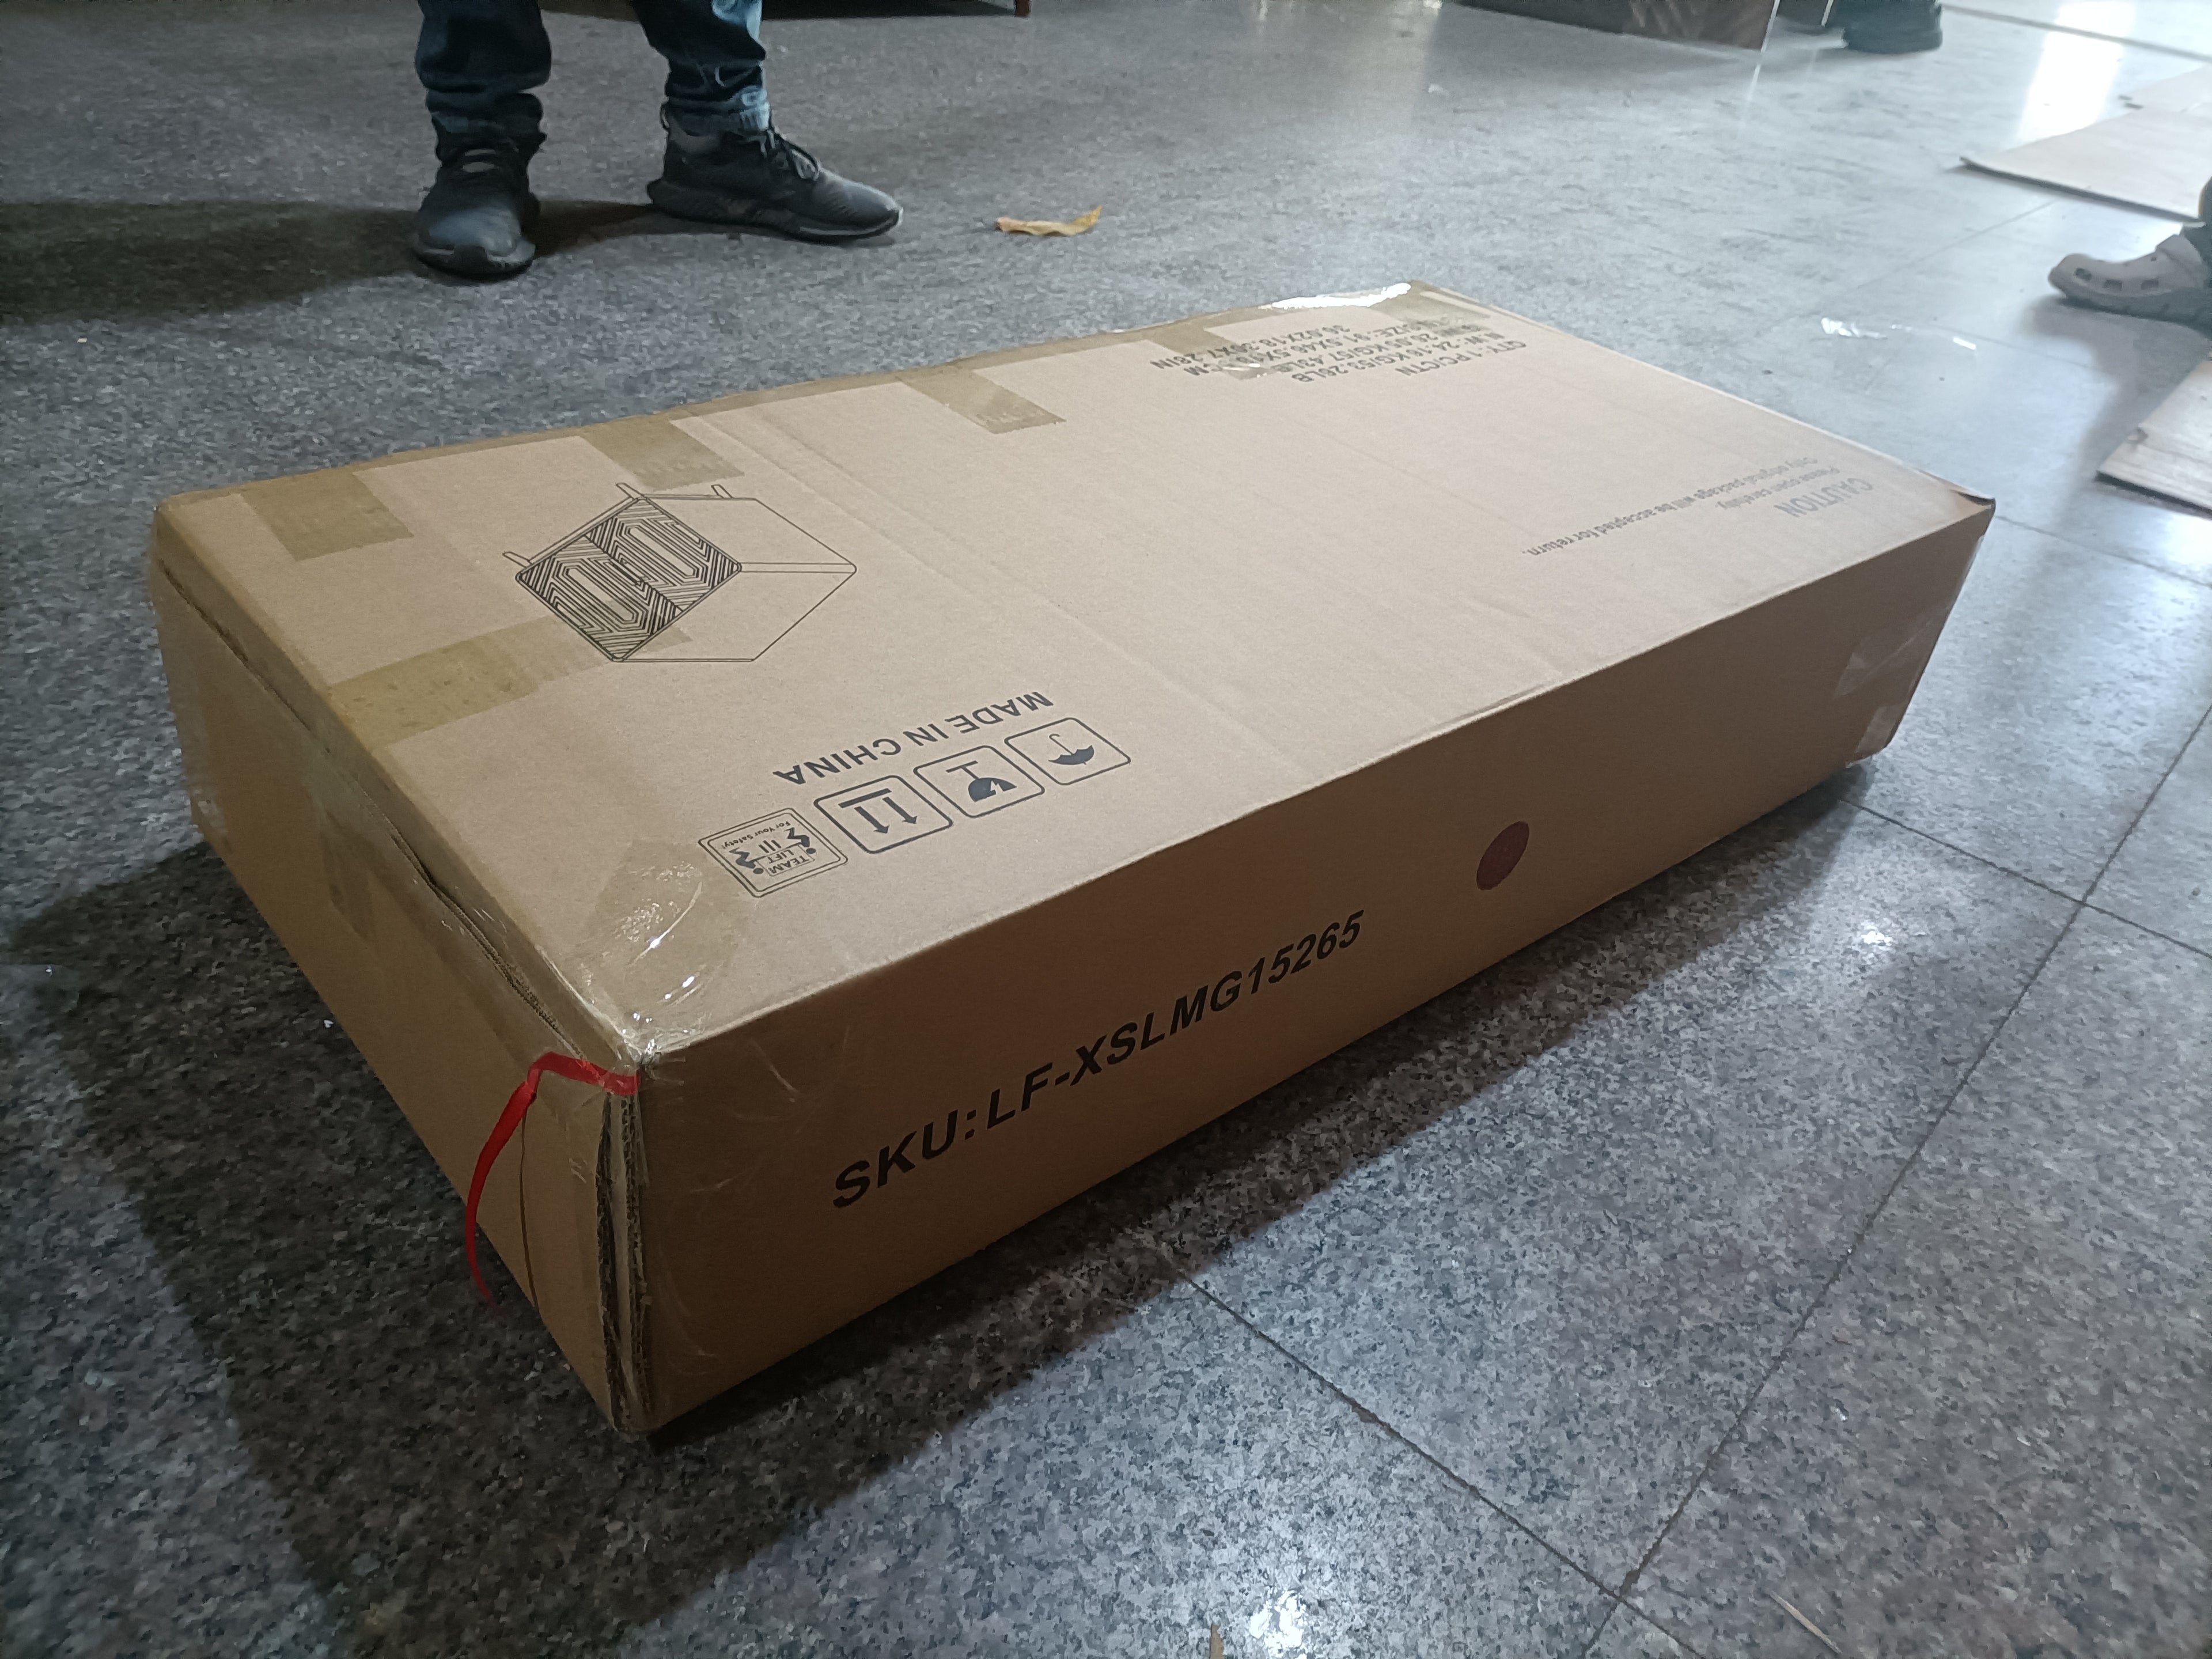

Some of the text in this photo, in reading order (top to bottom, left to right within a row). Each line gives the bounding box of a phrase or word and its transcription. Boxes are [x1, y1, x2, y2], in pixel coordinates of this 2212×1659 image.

[1479, 340, 1526, 354] QTY:
[1395, 353, 1471, 376] PC/CTN
[1694, 479, 1745, 499] package
[1774, 478, 1873, 517] CAUTION
[1654, 503, 1677, 512] be
[1594, 509, 1657, 535] accepted
[1573, 530, 1600, 540] for
[1522, 537, 1575, 555] return.
[772, 692, 1054, 785] MADE IN CHINA
[755, 827, 775, 836] Your
[722, 835, 753, 849] Safety!
[762, 850, 794, 863] LIFT
[768, 855, 809, 873] TEAM
